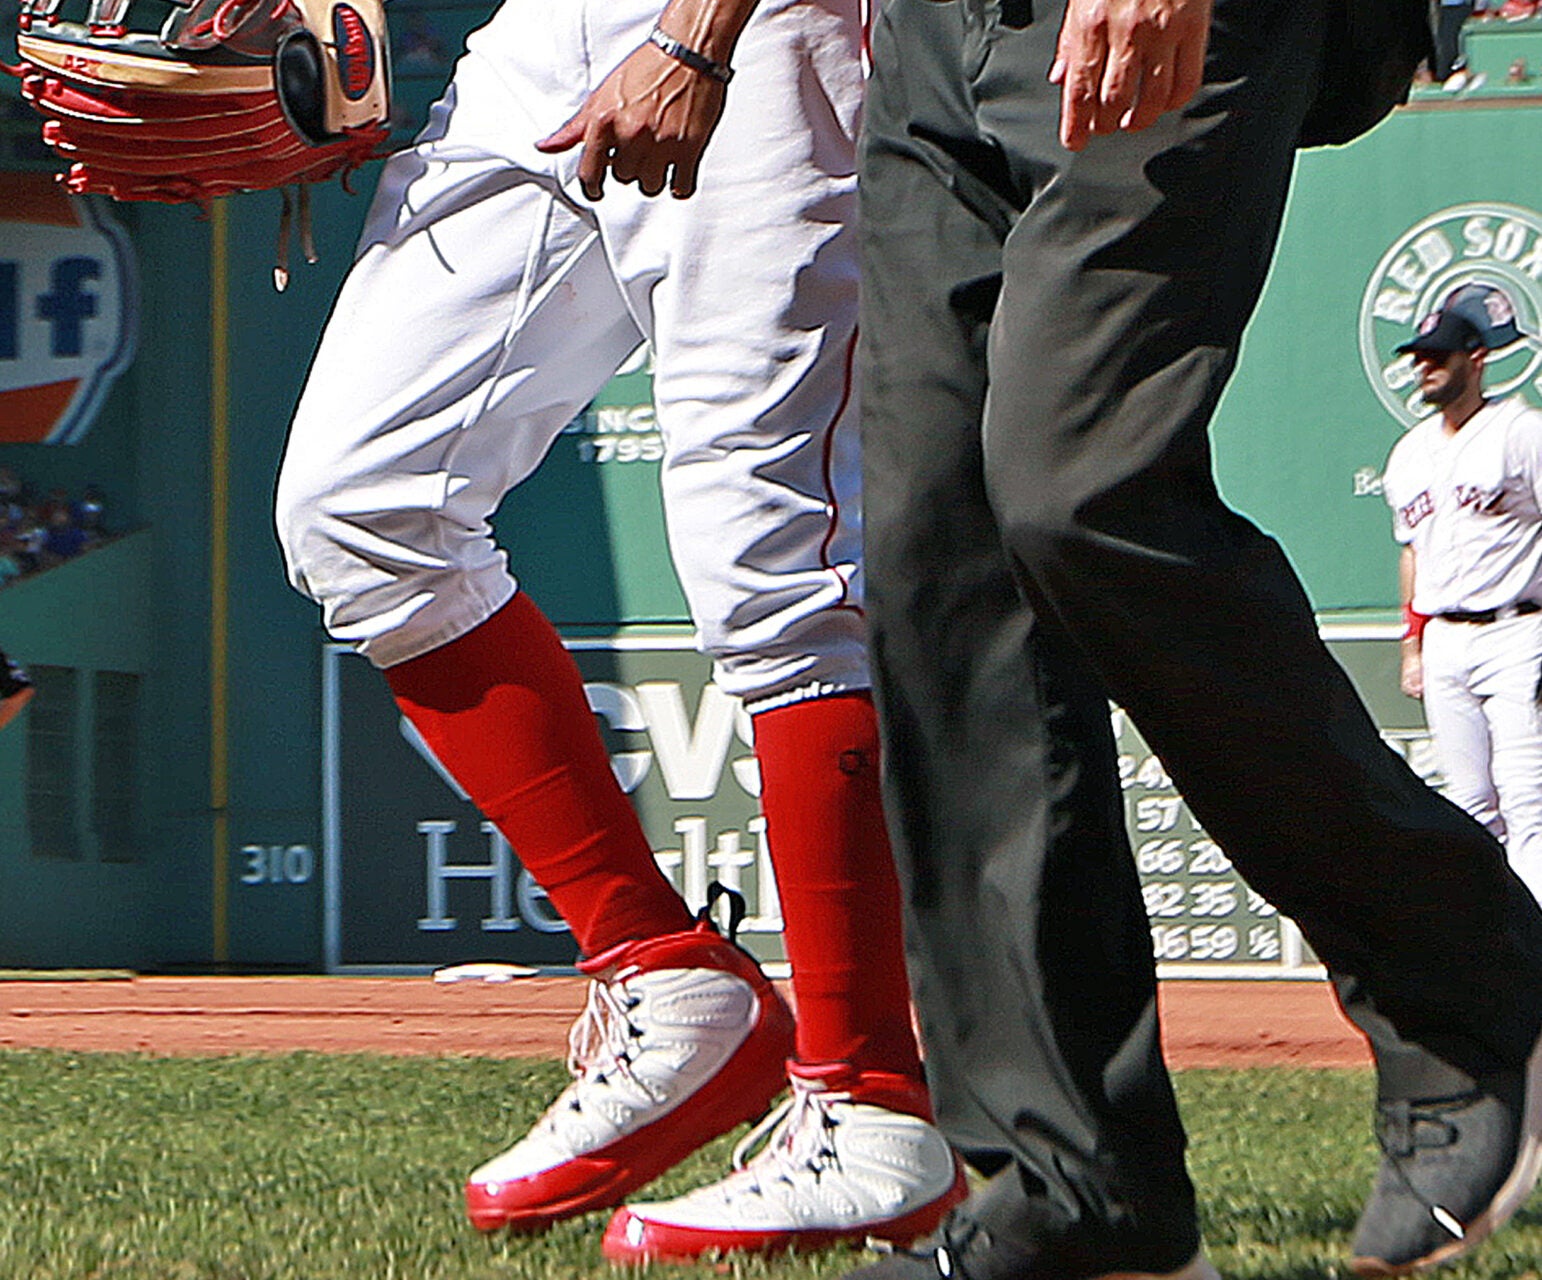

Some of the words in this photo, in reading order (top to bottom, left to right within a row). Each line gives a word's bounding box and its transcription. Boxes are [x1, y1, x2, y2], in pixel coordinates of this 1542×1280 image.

[1372, 228, 1454, 325] RED
[578, 437, 662, 462] 1795
[1136, 797, 1183, 831] 57
[240, 845, 313, 883] 310
[1136, 840, 1185, 874] 66
[1189, 882, 1238, 917] 35
[1189, 925, 1238, 960] 59
